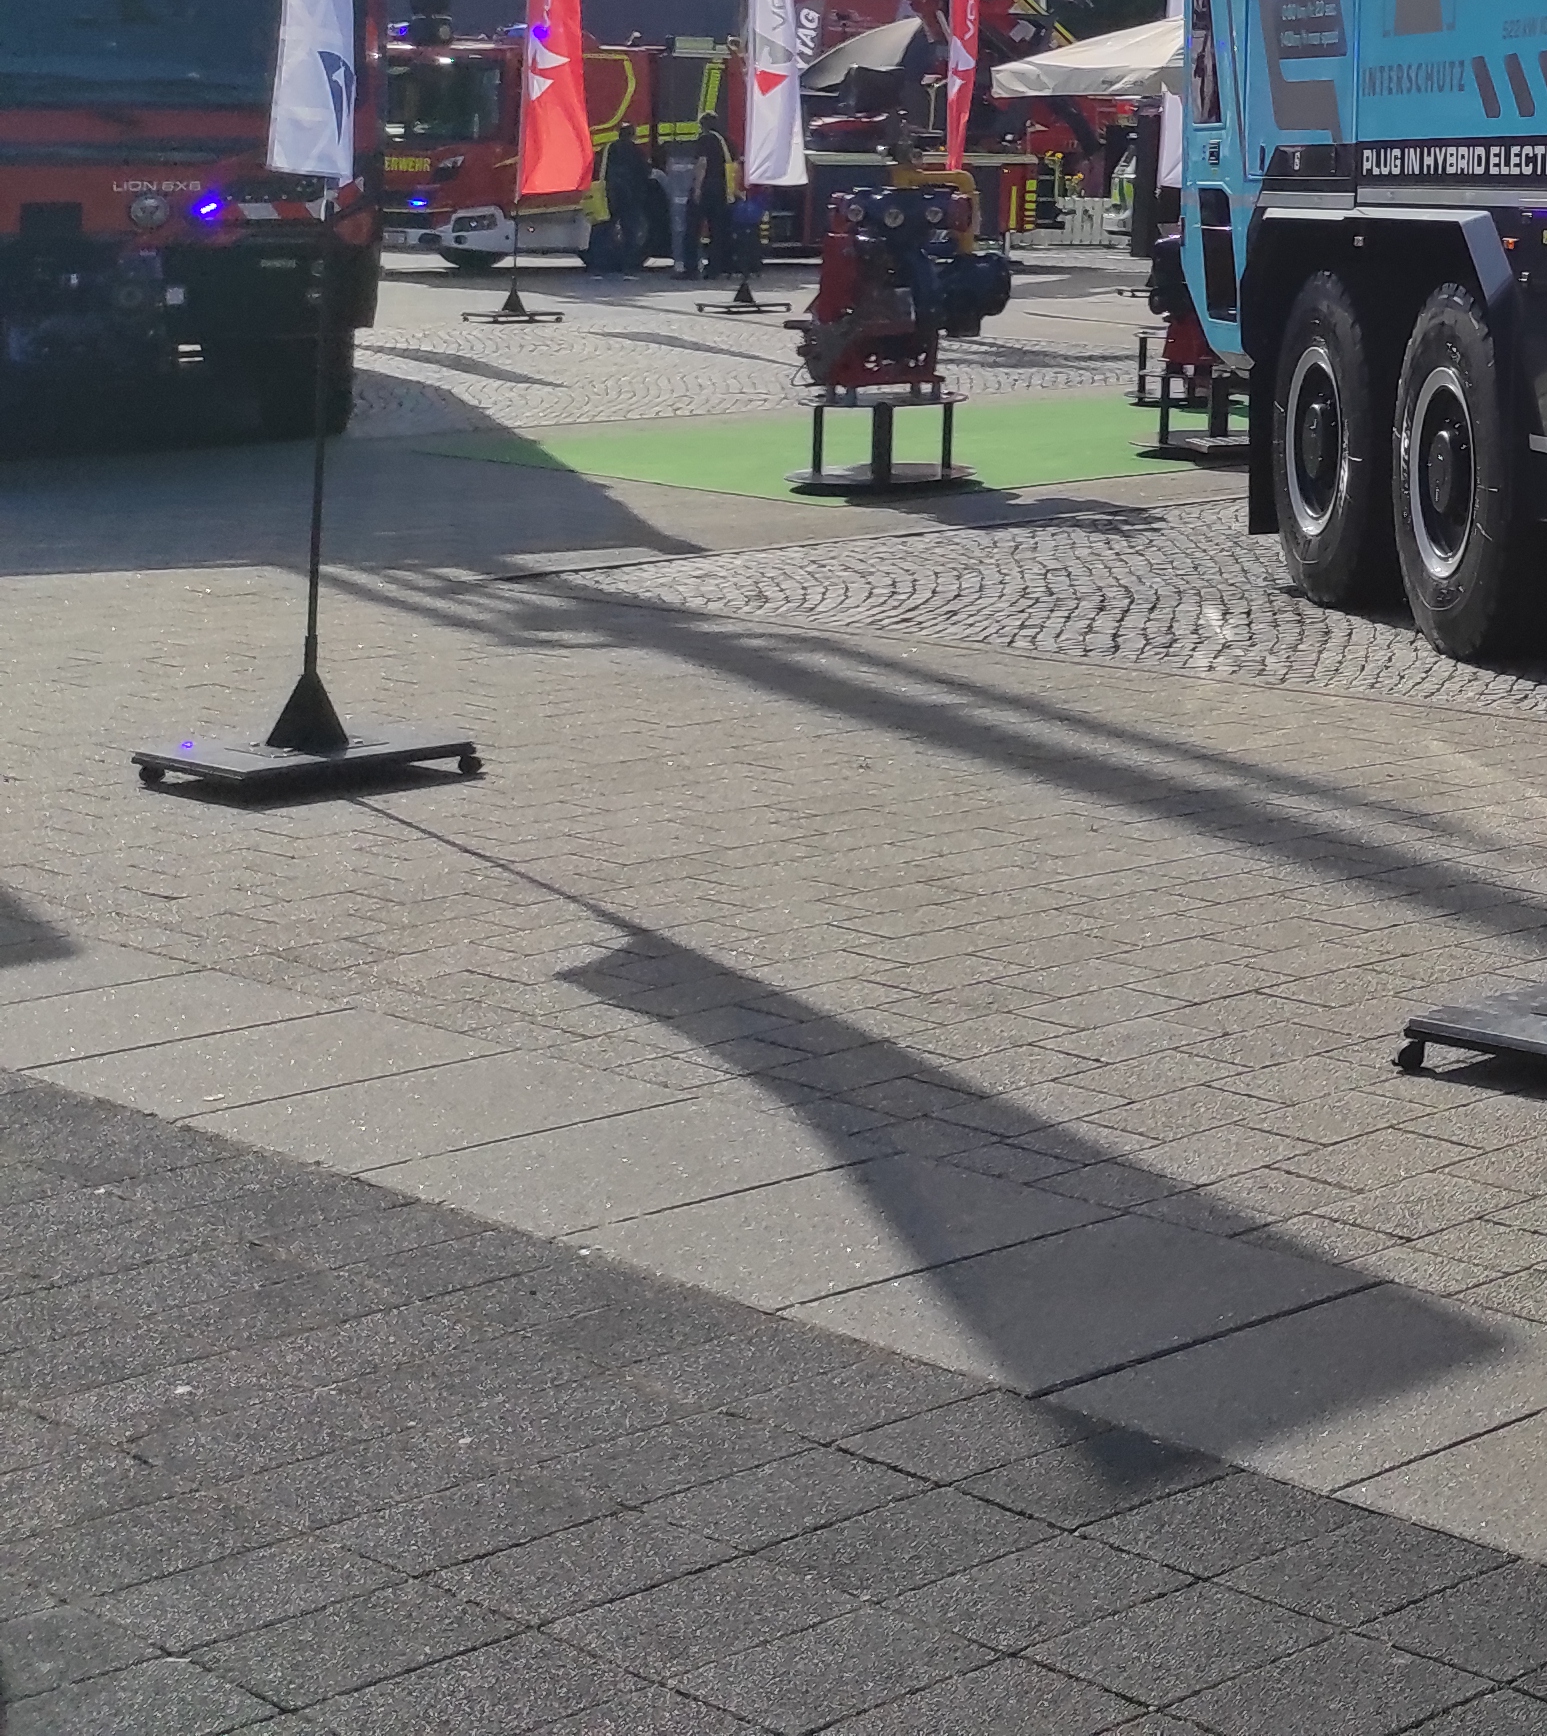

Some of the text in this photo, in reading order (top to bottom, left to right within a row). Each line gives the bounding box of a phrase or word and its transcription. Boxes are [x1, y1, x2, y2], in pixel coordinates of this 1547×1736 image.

[1361, 59, 1466, 97] INTERSCHUTZ
[1362, 147, 1401, 175] PLUG
[1404, 147, 1420, 175] IN
[1423, 145, 1486, 175] HYBRID
[113, 181, 201, 192] LION 6X6
